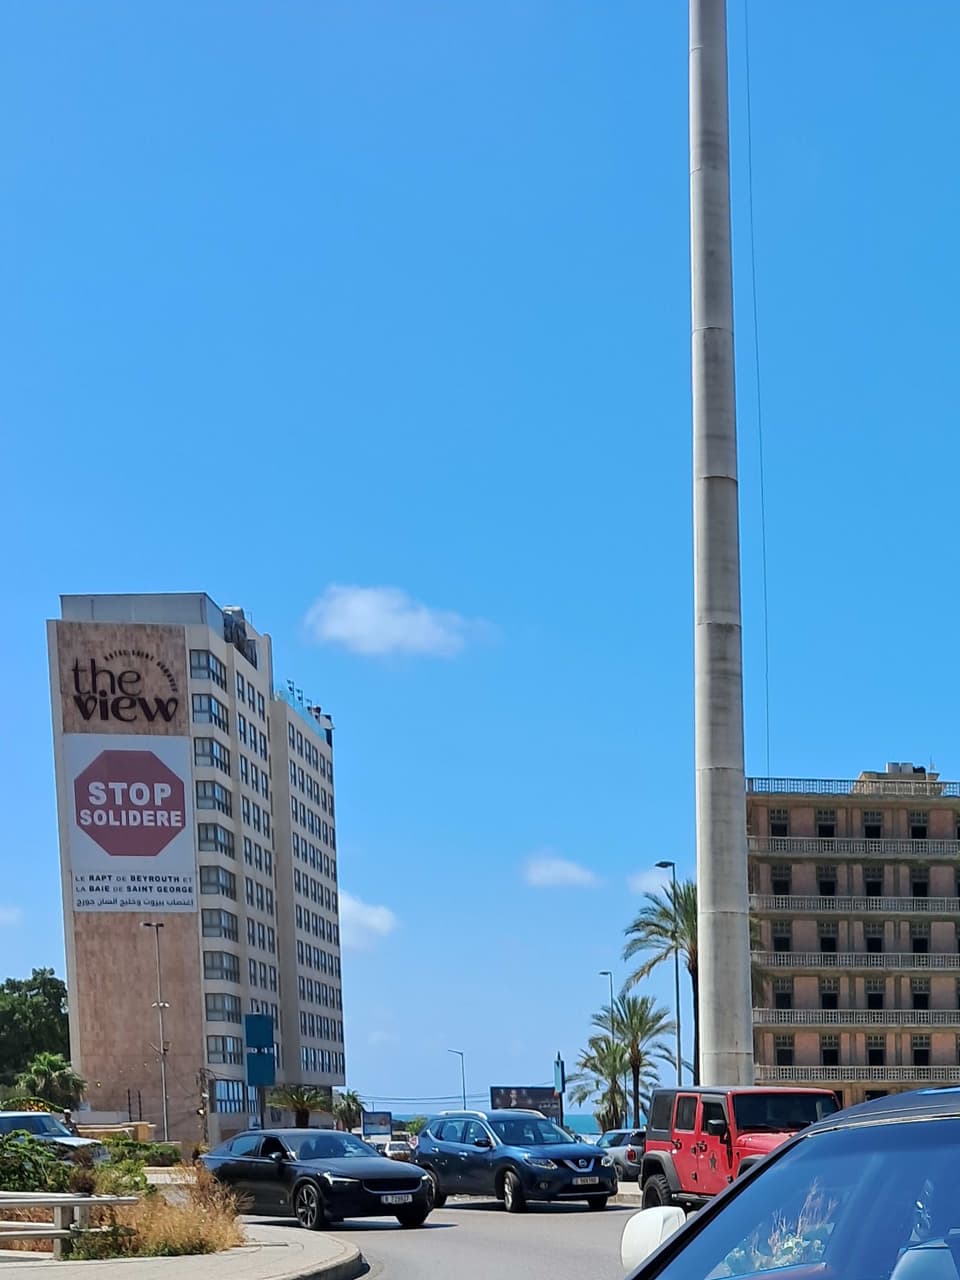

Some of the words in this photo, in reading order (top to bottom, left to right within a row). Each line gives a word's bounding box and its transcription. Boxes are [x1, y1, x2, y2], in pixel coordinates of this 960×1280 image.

[72, 658, 142, 697] the
[73, 690, 178, 722] view
[88, 781, 171, 806] STOP
[80, 809, 182, 827] SOLIDERE
